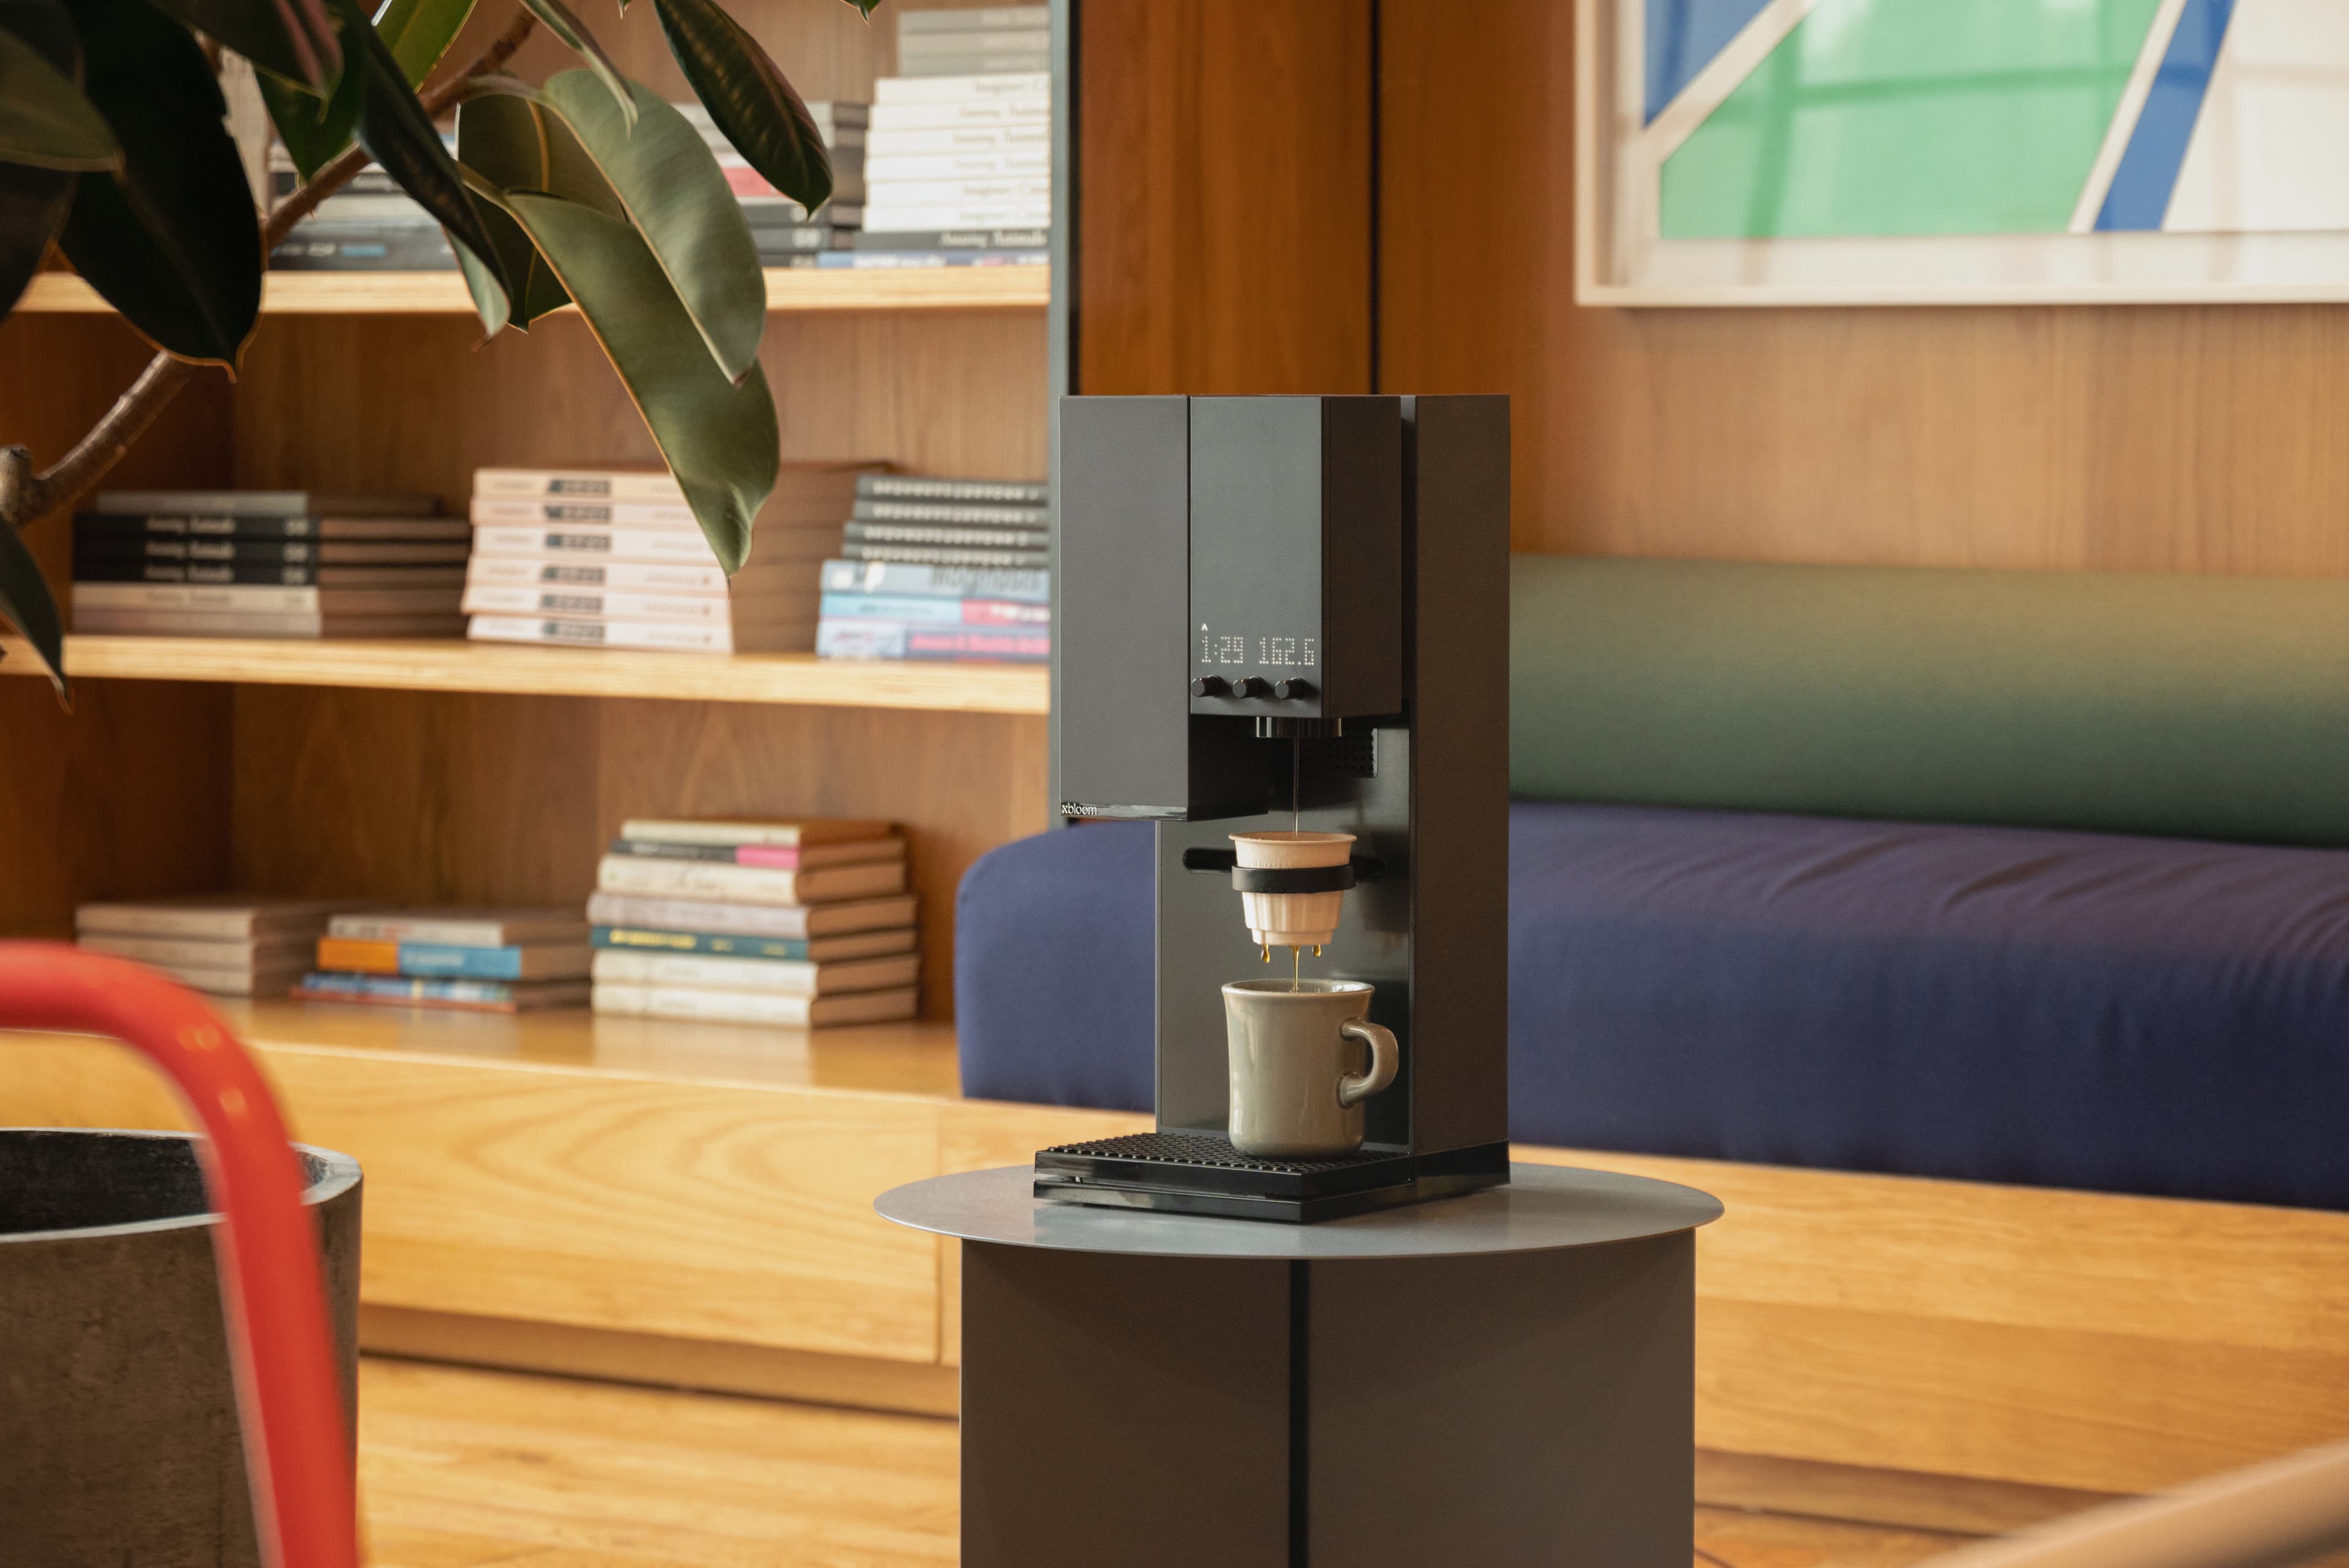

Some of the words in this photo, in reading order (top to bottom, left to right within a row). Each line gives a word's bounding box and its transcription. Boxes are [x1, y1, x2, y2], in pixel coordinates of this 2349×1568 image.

[1201, 636, 1243, 664] 1:29
[1259, 637, 1315, 666] 162.6
[1061, 803, 1097, 816] xbloom
